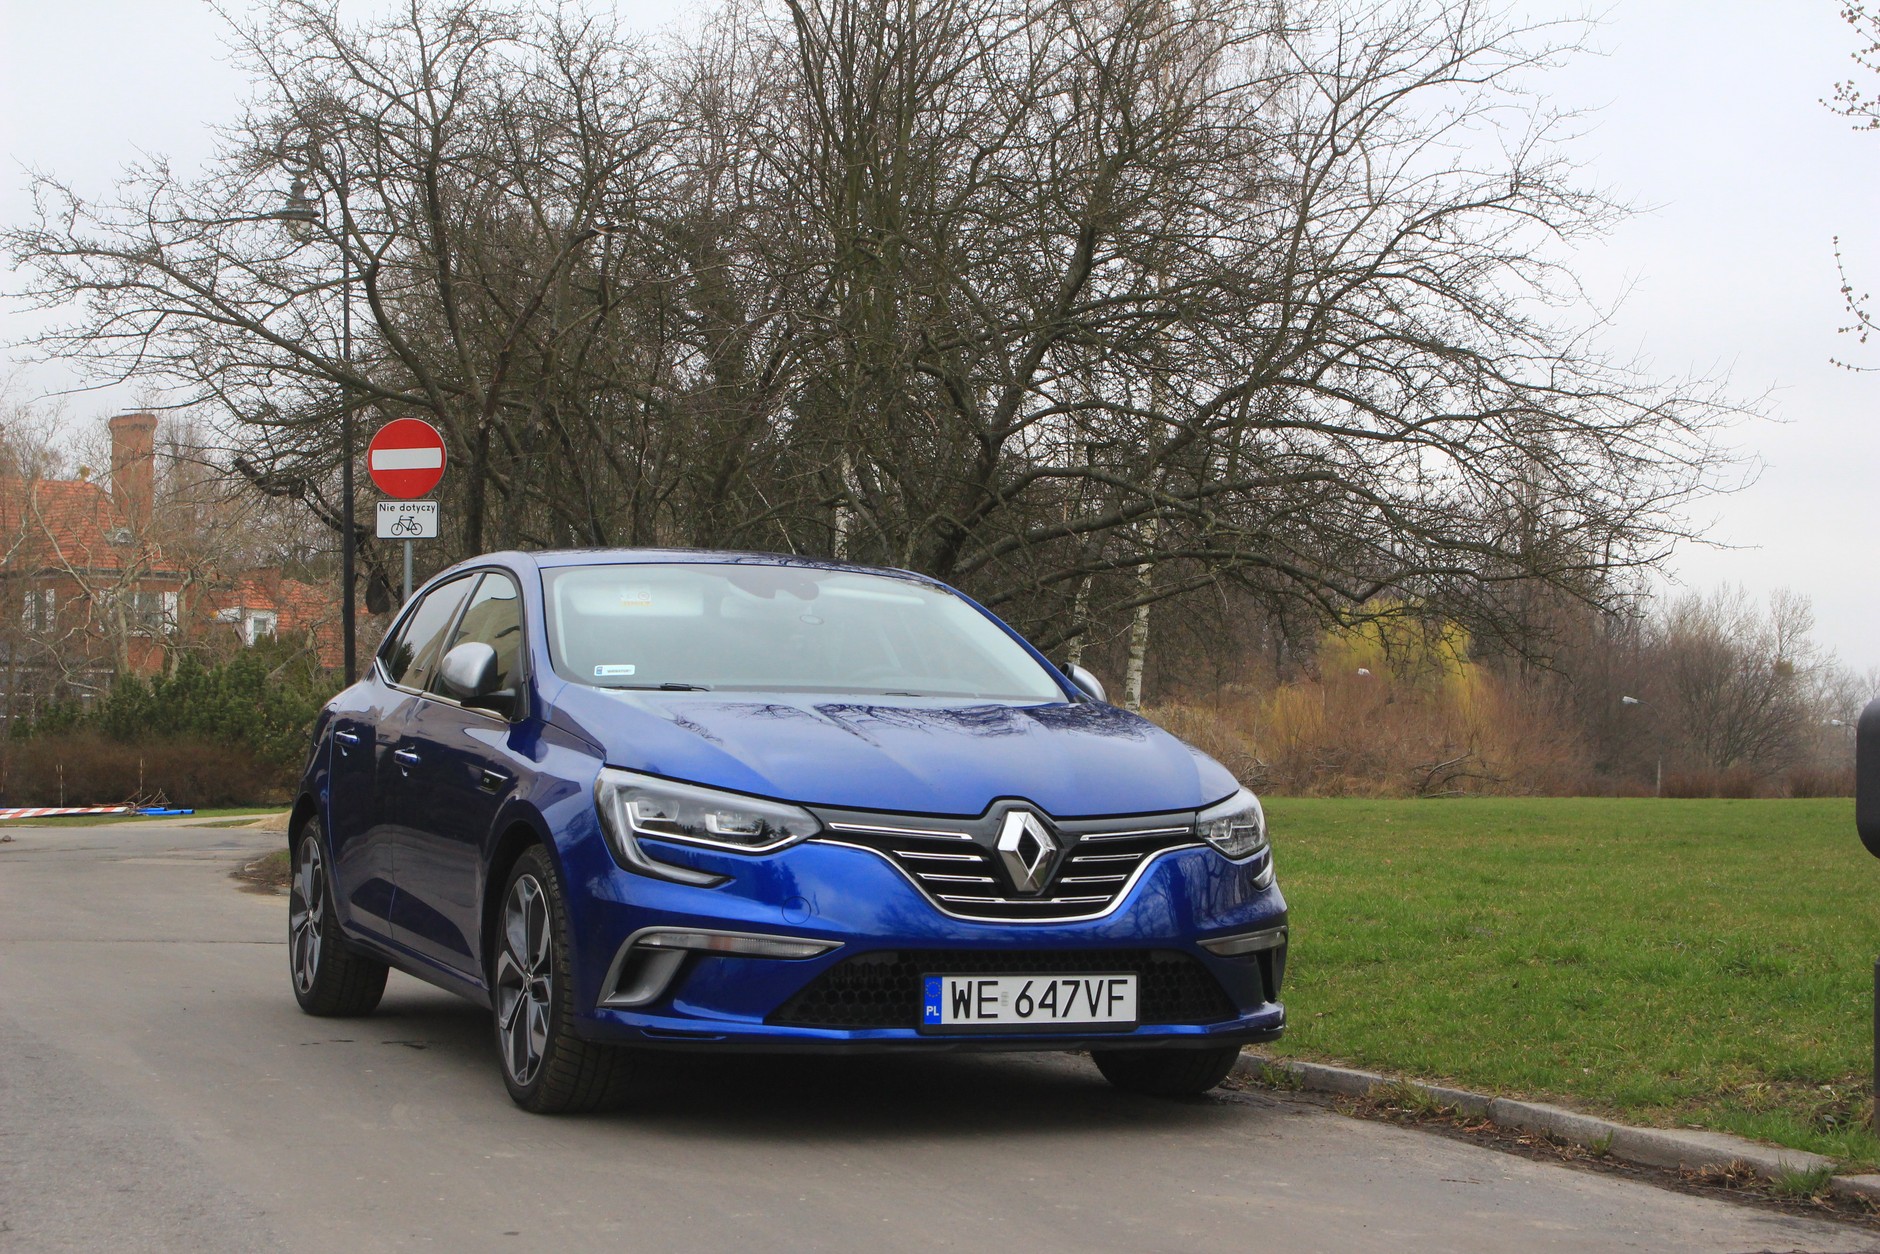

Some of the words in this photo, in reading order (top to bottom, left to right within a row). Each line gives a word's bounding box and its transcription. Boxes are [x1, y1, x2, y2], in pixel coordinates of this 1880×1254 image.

[379, 503, 395, 512] Nie
[399, 503, 436, 514] dotyczy
[951, 980, 999, 1019] WE
[1014, 979, 1128, 1018] 647VF
[925, 1005, 940, 1016] PL
